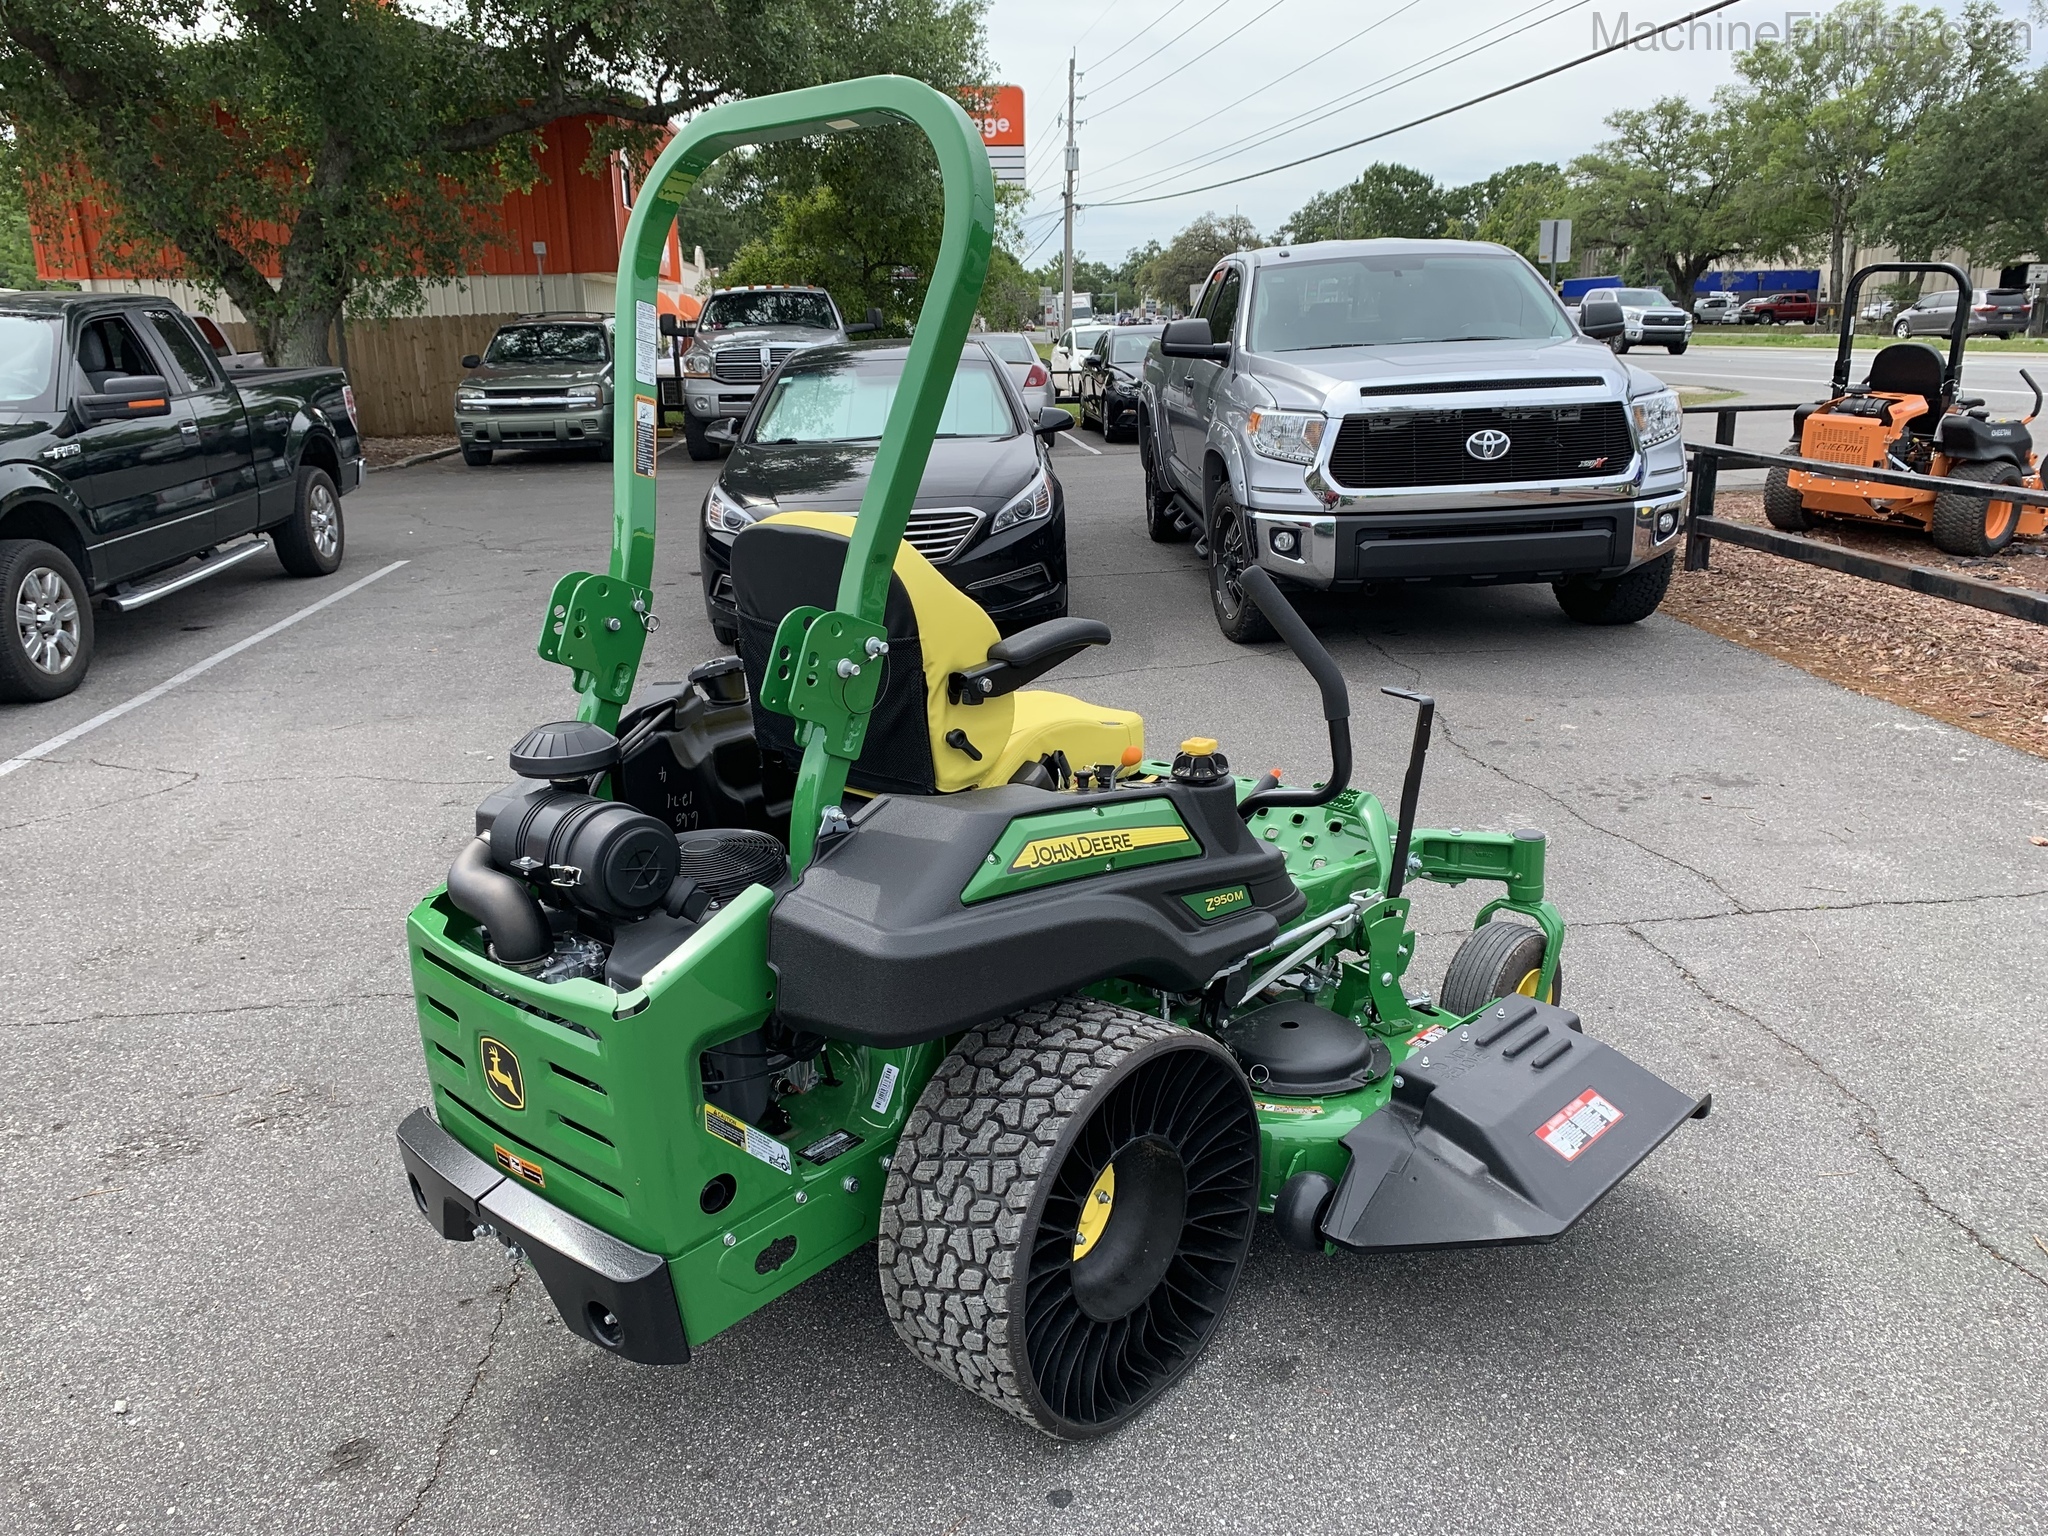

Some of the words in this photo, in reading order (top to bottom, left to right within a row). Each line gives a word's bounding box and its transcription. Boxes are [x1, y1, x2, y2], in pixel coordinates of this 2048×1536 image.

[1816, 442, 1863, 453] CHEETAH
[1031, 841, 1077, 866] JOHN
[1077, 833, 1134, 857] DEERE
[1205, 890, 1244, 913] Z950M
